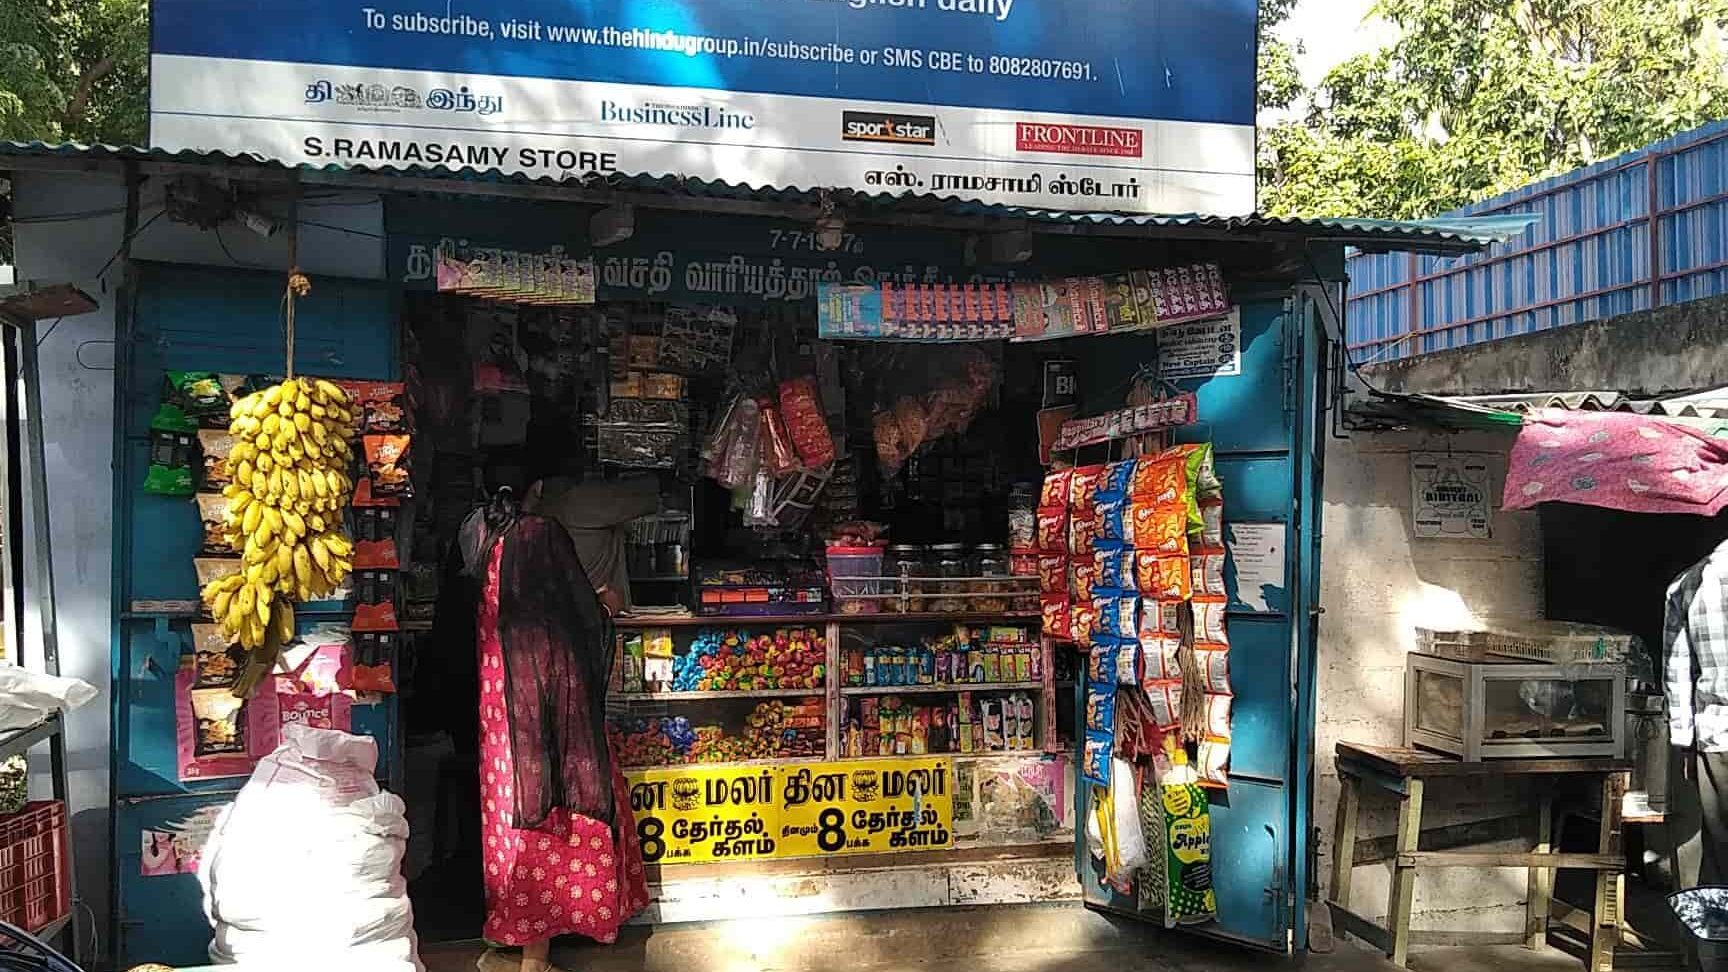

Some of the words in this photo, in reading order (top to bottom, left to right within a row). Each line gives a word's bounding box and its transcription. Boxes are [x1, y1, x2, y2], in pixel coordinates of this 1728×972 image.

[363, 8, 386, 29] To
[393, 13, 495, 41] subscribe,
[500, 19, 542, 42] visit
[547, 25, 855, 64] www.thehindugroup.in/subscribe
[859, 50, 879, 65] or
[883, 48, 923, 69] SMS
[928, 52, 962, 72] CBE
[968, 55, 984, 73] to
[989, 56, 1099, 82] 8082807691.
[425, 86, 504, 116] இந்து
[601, 100, 754, 130] BusinessLine
[847, 117, 931, 140] sportstar
[1021, 124, 1139, 148] FRONTLINE
[303, 136, 509, 166] S.RAMASAMY
[518, 147, 618, 172] STORE
[864, 164, 924, 187] எஸ்.
[930, 171, 1043, 194] ராமசாமி
[1047, 173, 1142, 198] ஸ்டோர்
[630, 781, 669, 812] ன
[705, 768, 774, 806] மலர்
[783, 768, 849, 811] தின
[882, 762, 946, 798] மலர்
[671, 812, 764, 845] தேர்தல்
[816, 807, 847, 852] 8
[851, 803, 939, 835] தேர்தல்
[888, 822, 949, 847] களம்
[637, 816, 667, 862] 8
[711, 831, 776, 857] களம்
